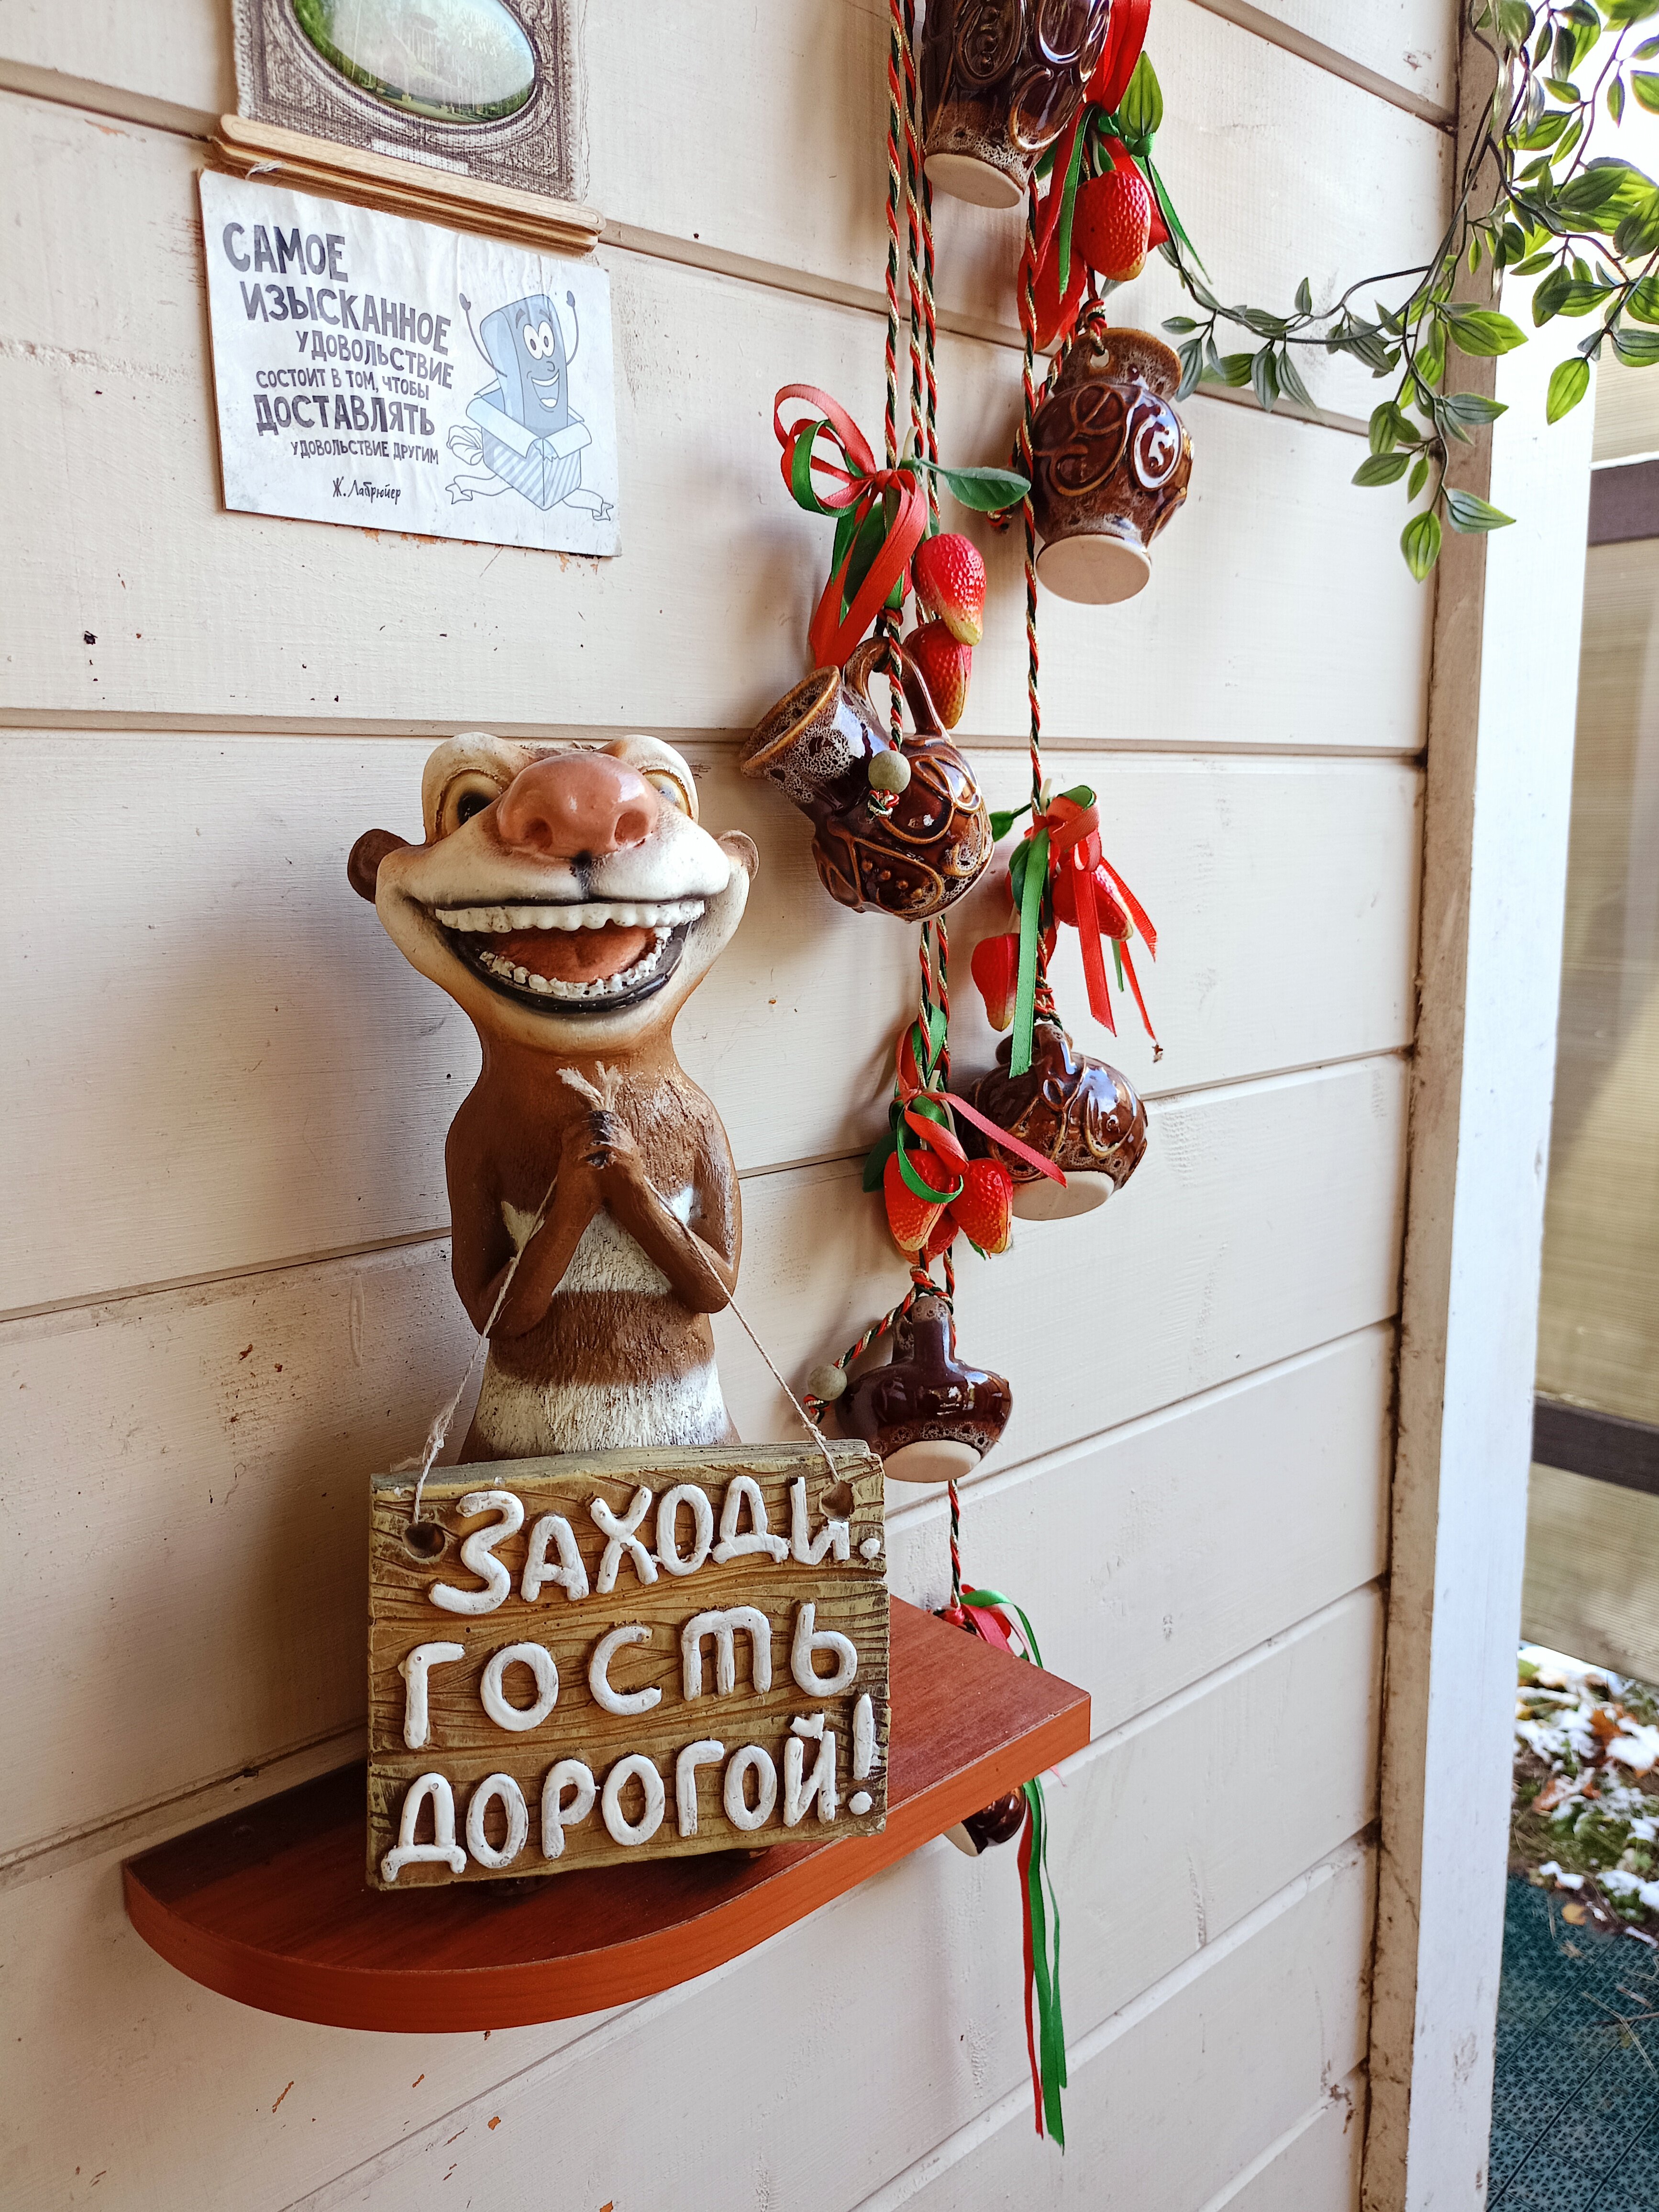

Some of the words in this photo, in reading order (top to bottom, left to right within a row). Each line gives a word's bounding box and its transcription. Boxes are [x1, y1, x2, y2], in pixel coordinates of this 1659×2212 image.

[223, 222, 348, 282] САМОЕ
[240, 281, 451, 355] ИЗЫСКАННОЕ
[256, 368, 325, 388] СОСТОИТ
[332, 368, 342, 387] В
[345, 370, 378, 393] ТОМ,
[382, 376, 429, 400] ЧТОБЫ
[296, 331, 453, 389] УДОВОЛЬСТВИЕ
[254, 394, 435, 436] ДОСТАВЛЯТЬ
[291, 439, 390, 458] УДОВОЛЬСТВИЕ
[393, 442, 438, 464] ДРУГИМ
[348, 480, 401, 505] Лабрюйер
[398, 1601, 858, 1749] ГОСТЬ
[381, 1693, 876, 1882] ДОРОГОЙ!
